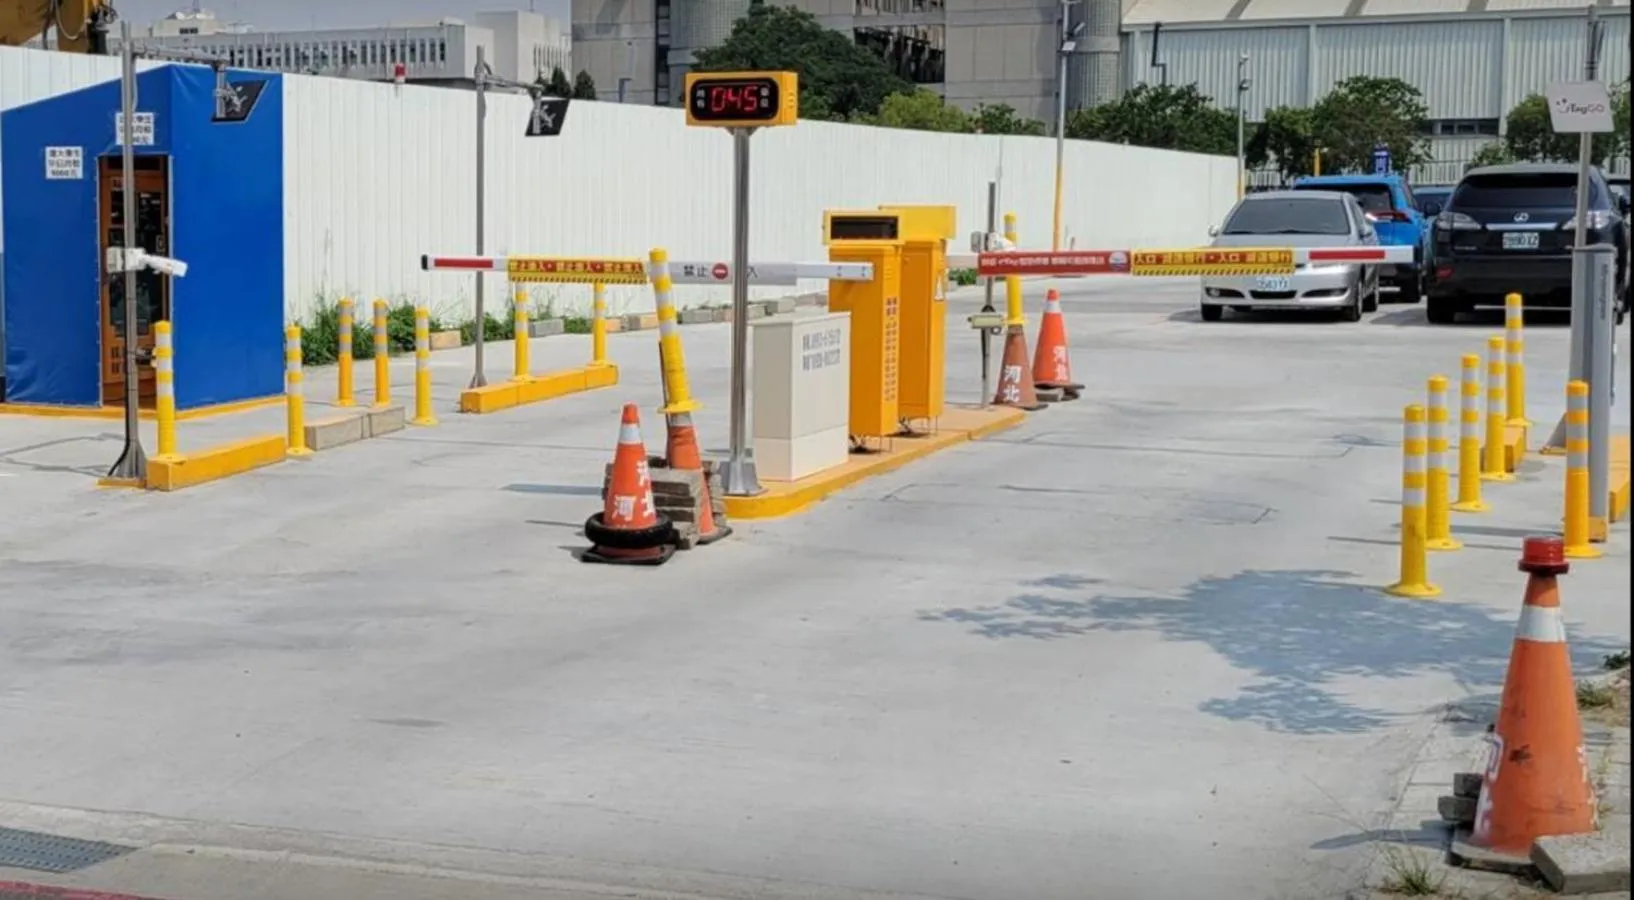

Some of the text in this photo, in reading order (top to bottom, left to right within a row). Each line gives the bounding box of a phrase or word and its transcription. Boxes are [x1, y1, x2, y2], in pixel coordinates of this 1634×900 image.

[711, 86, 758, 112] 045
[1136, 253, 1156, 264] 入口
[1219, 252, 1240, 263] 入口
[684, 265, 707, 278] 禁止
[1003, 365, 1022, 403] 河北
[612, 495, 638, 521] 河
